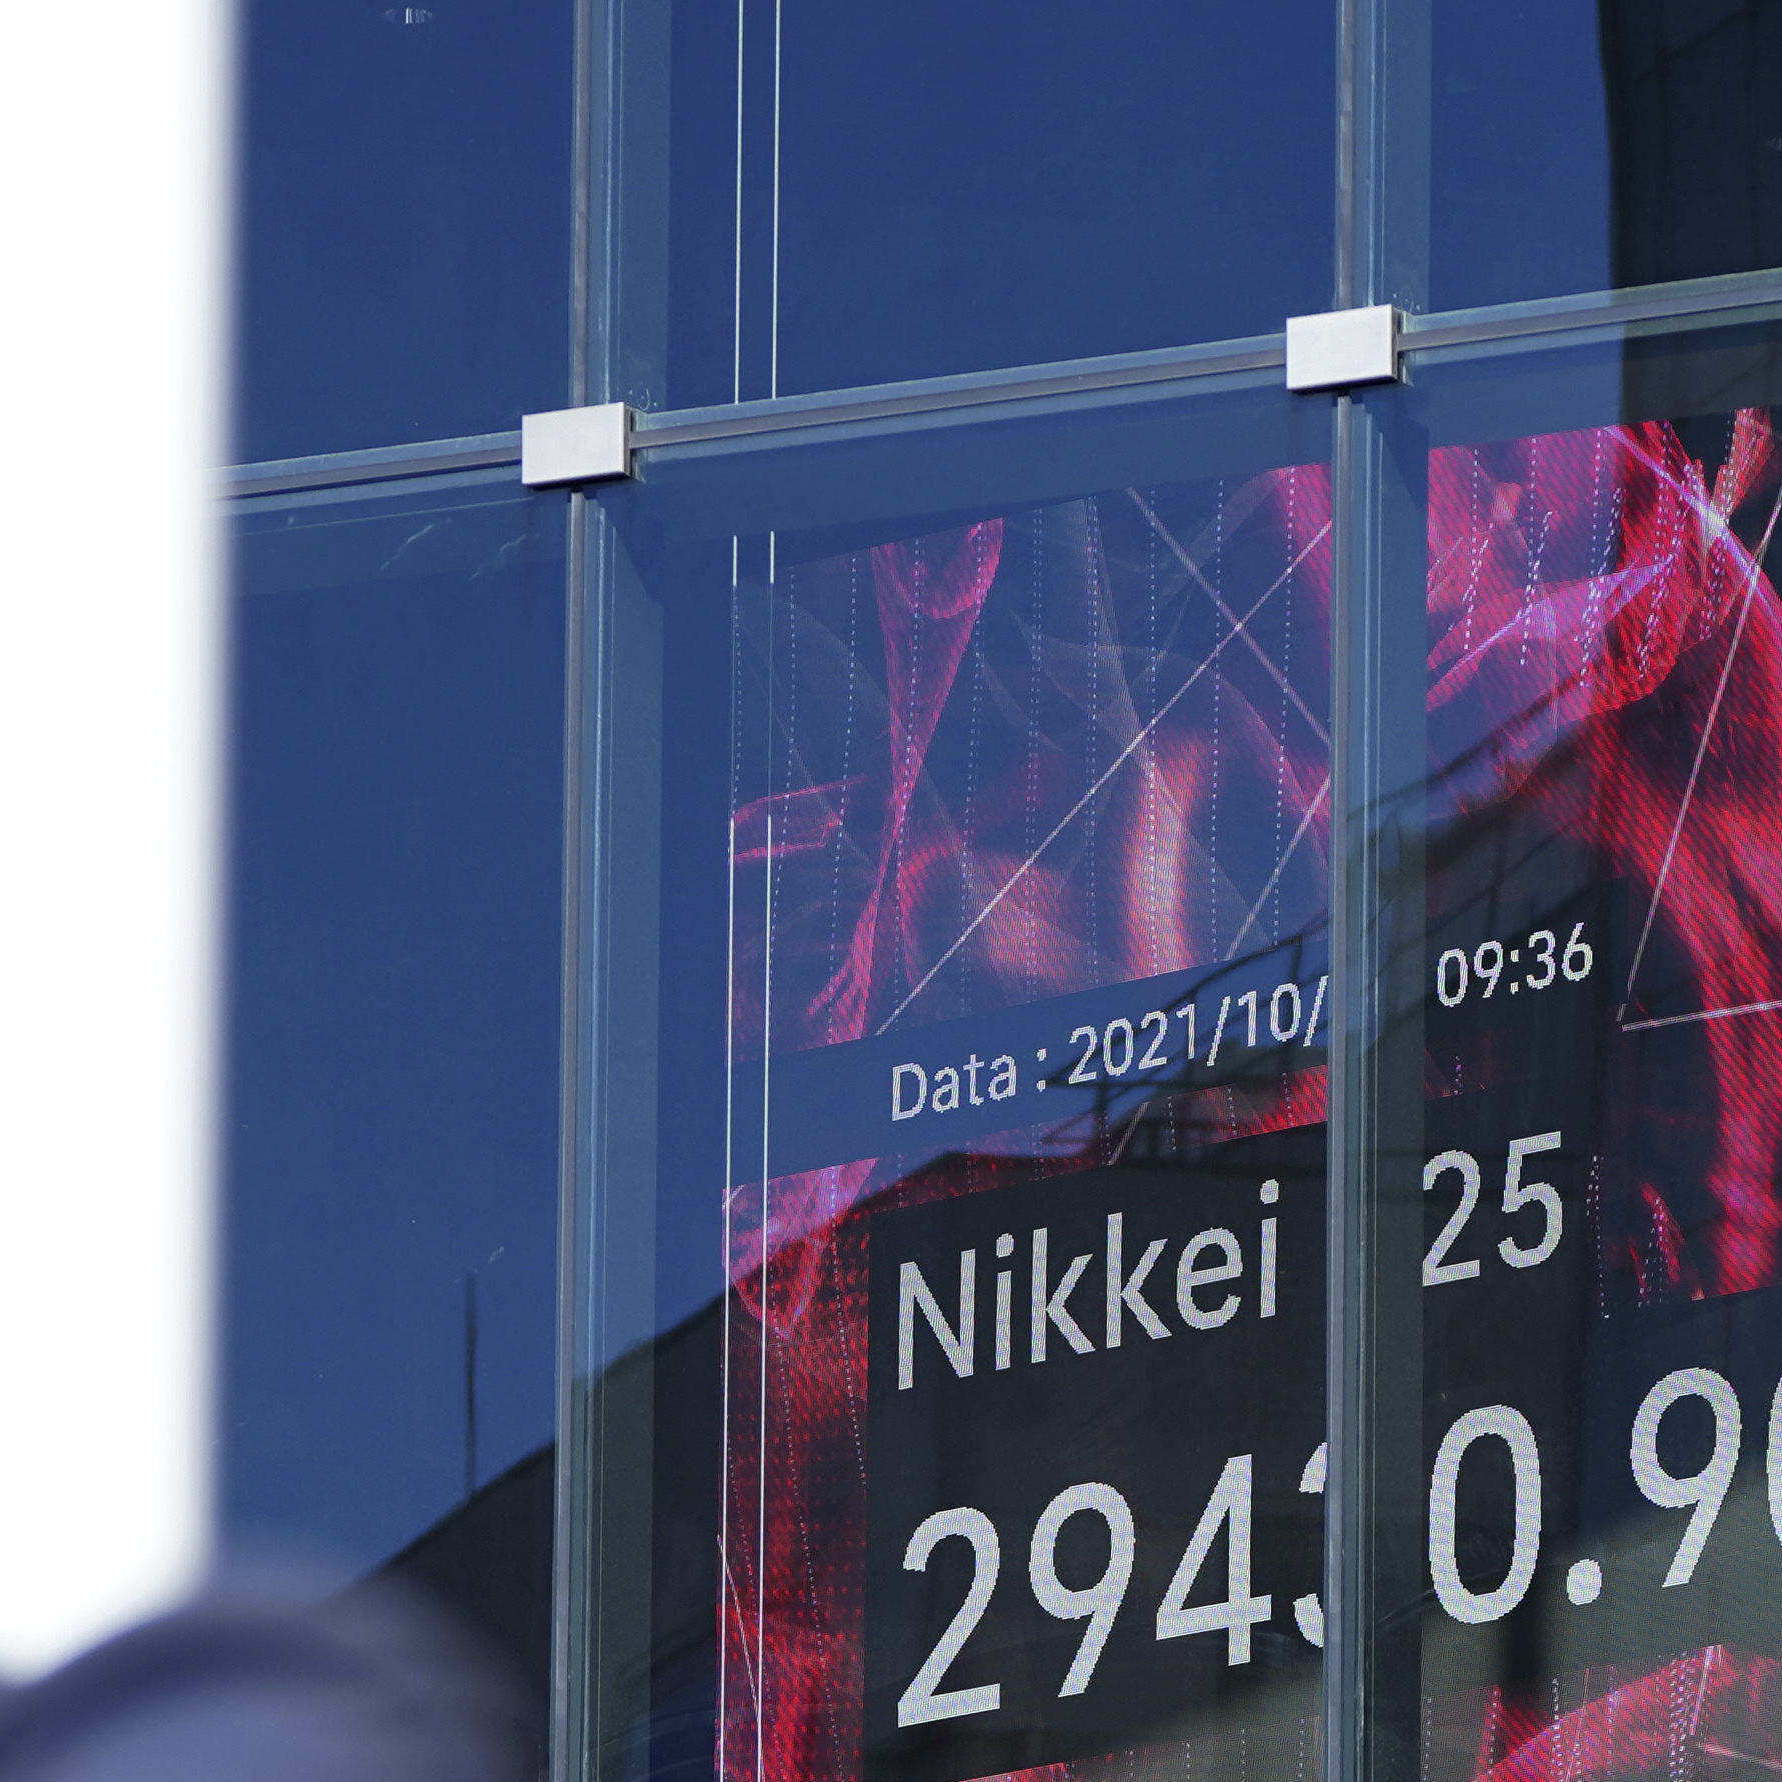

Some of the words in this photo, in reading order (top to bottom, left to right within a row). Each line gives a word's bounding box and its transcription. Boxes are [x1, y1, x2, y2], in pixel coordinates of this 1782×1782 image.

[891, 1053, 1017, 1122] Data
[1068, 975, 1329, 1084] 2021/10/
[1436, 922, 1595, 1008] 09:36
[898, 1178, 1281, 1392] Nikkei
[1421, 1130, 1563, 1287] 25
